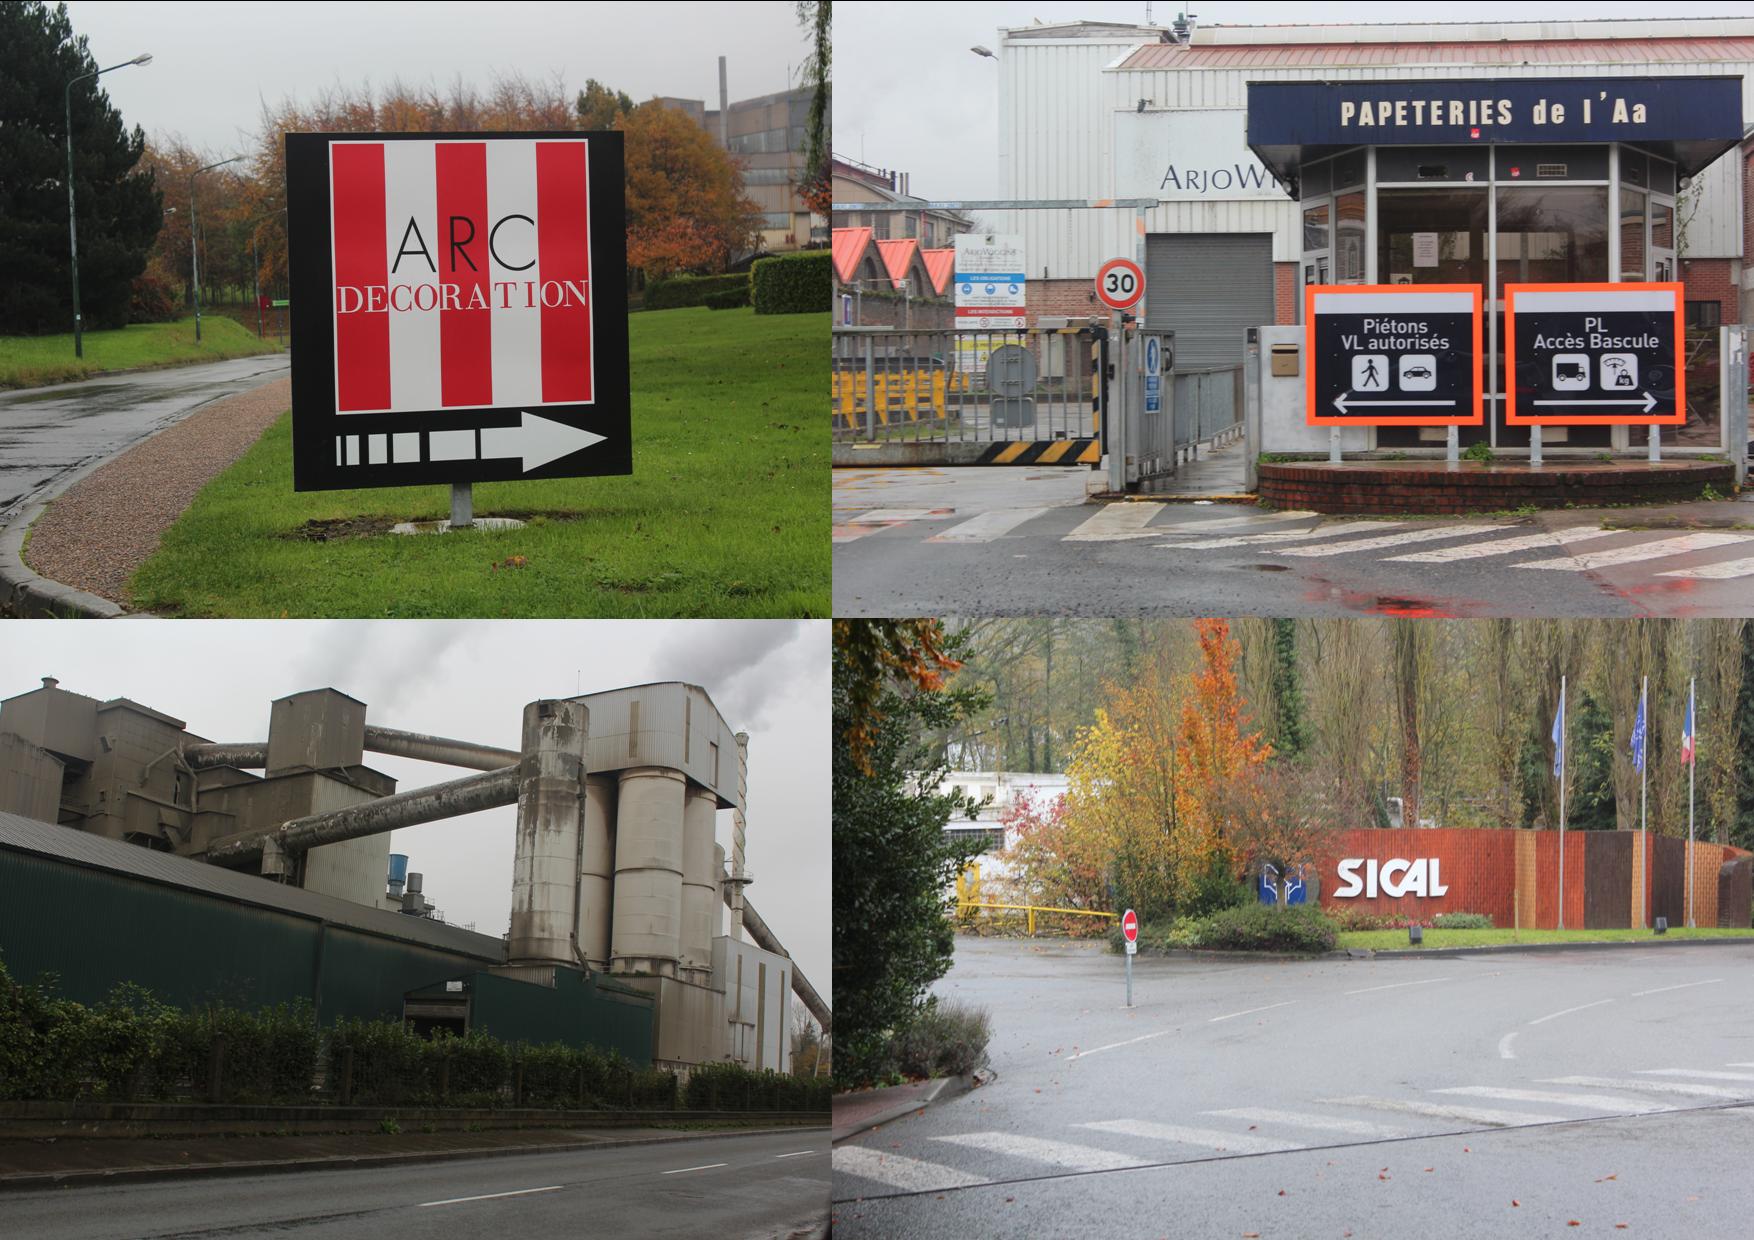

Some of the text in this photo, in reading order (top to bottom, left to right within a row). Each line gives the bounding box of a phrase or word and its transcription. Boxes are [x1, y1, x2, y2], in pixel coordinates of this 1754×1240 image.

[1341, 100, 1512, 126] PAPETERIES
[1533, 99, 1566, 125] de
[391, 214, 536, 273] ARC
[1106, 273, 1134, 293] 30
[337, 280, 589, 314] DECORATION
[1363, 318, 1429, 335] Piétons
[1585, 317, 1608, 333] PL
[1341, 333, 1450, 350] VL autorisés
[1533, 333, 1660, 349] Accès Bascule
[1619, 376, 1630, 386] kg
[1333, 857, 1449, 899] SICAL
